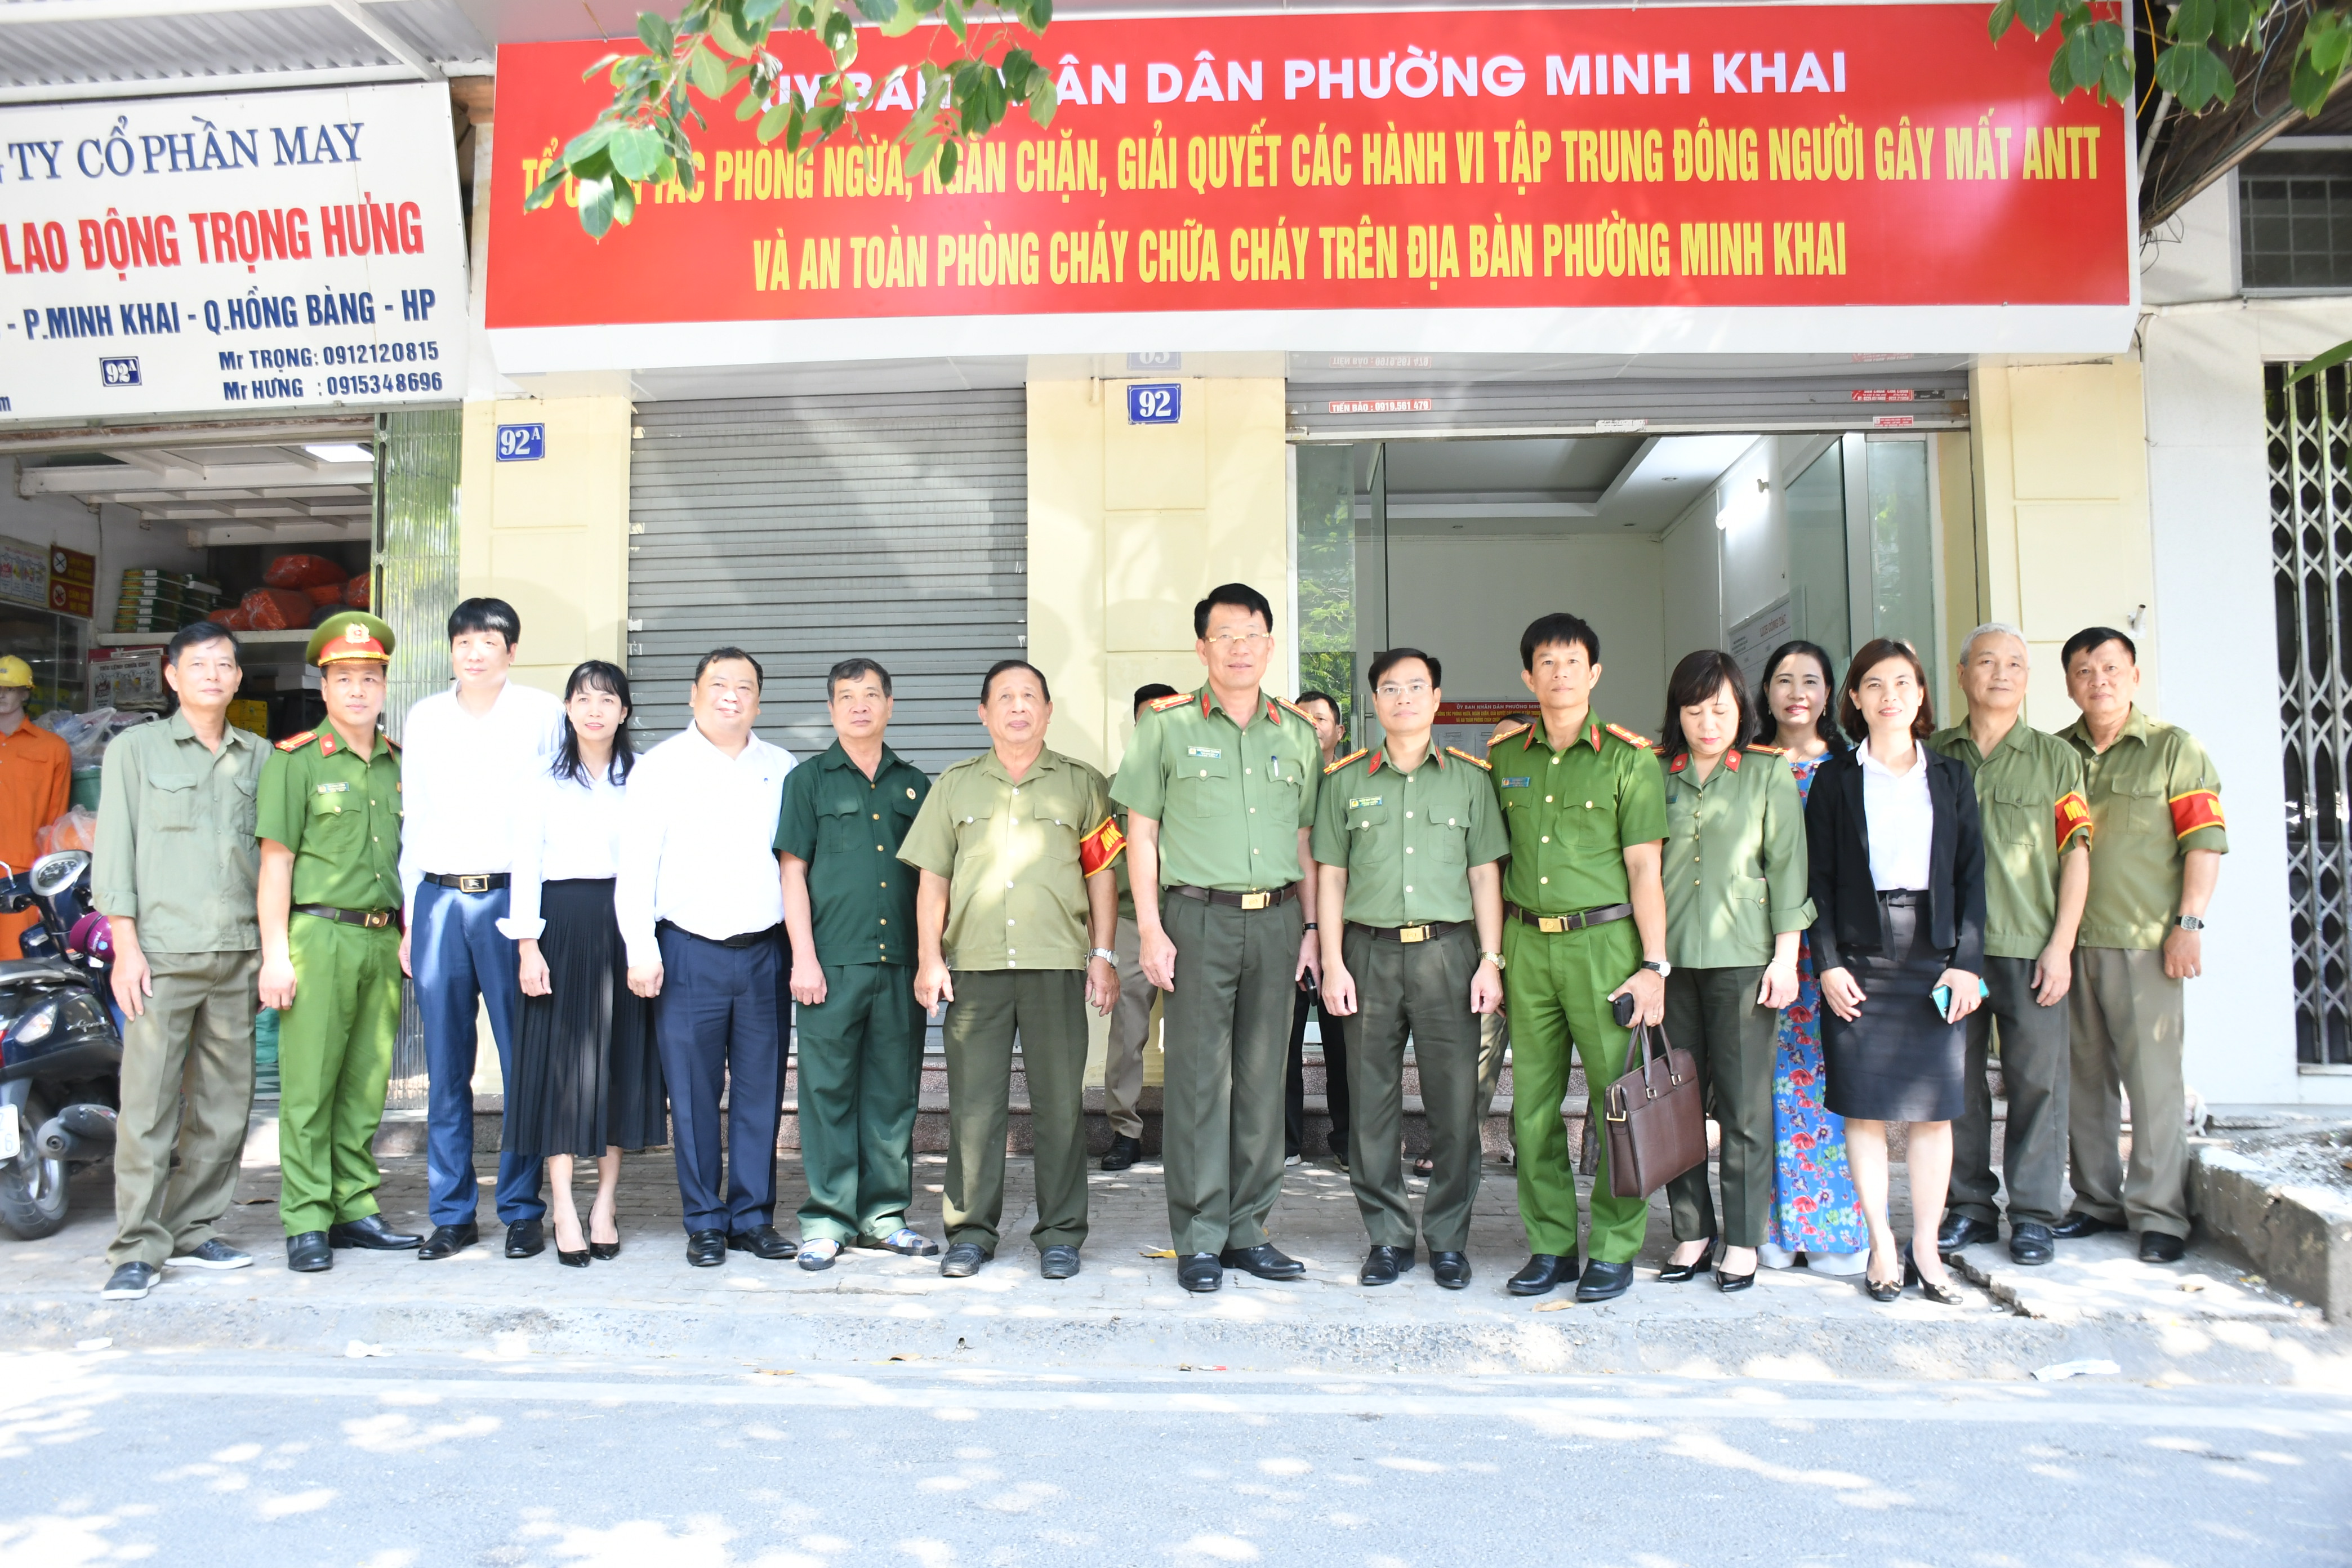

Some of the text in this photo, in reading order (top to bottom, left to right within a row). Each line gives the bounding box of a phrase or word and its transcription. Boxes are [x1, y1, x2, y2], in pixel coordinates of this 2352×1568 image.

[966, 54, 1126, 107] ÂN
[1147, 51, 1262, 103] DÂN
[1285, 45, 1526, 100] PHƯỜNG
[1545, 54, 1690, 95] MINH
[1713, 52, 1845, 93] KHAI
[8, 115, 362, 181] TY CỔ PHẦN MAY
[822, 134, 914, 204] NGỪA,
[1017, 124, 1107, 203] CHẶN,
[1117, 119, 1177, 190] GIẢI
[1188, 118, 1281, 194] QUYẾT
[1291, 123, 1352, 187] CÁC
[1362, 121, 1446, 185] HÀNH
[1455, 131, 1484, 184] VI
[1494, 119, 1552, 195] TẬP
[1561, 129, 1663, 182] TRUNG
[1672, 118, 1758, 182] ĐÔNG
[1769, 114, 1864, 181] NGƯỜI
[1875, 116, 1934, 181] GÂY
[1946, 109, 2008, 179] MẤT
[2023, 127, 2100, 179] ANTT
[0, 191, 424, 281] LAO ĐỘNG TRỌNG HƯNG
[753, 210, 1846, 291] VÀ AN TOÀN PHÒNG CHÁY CHỮA CHÁY TRÊN ĐỊA BÀN PHƯỜNG MINH KHAI
[24, 305, 114, 340] P.MINH
[120, 302, 181, 335] KHAI
[204, 286, 299, 336] Q.HỒNG
[305, 286, 376, 326] BÀNG
[401, 288, 435, 321] HP
[219, 341, 439, 372] Mr TRỌNG: 0912120815
[223, 381, 247, 400] Mr
[251, 377, 304, 399] HƯNG
[326, 372, 443, 395] 0915348696
[1139, 391, 1171, 417] 92
[1332, 402, 1350, 412] TIẾN
[1352, 402, 1369, 412] BẢO
[1375, 401, 1411, 411] 0919.561
[1414, 400, 1429, 411] 479
[1101, 824, 1123, 852] MK
